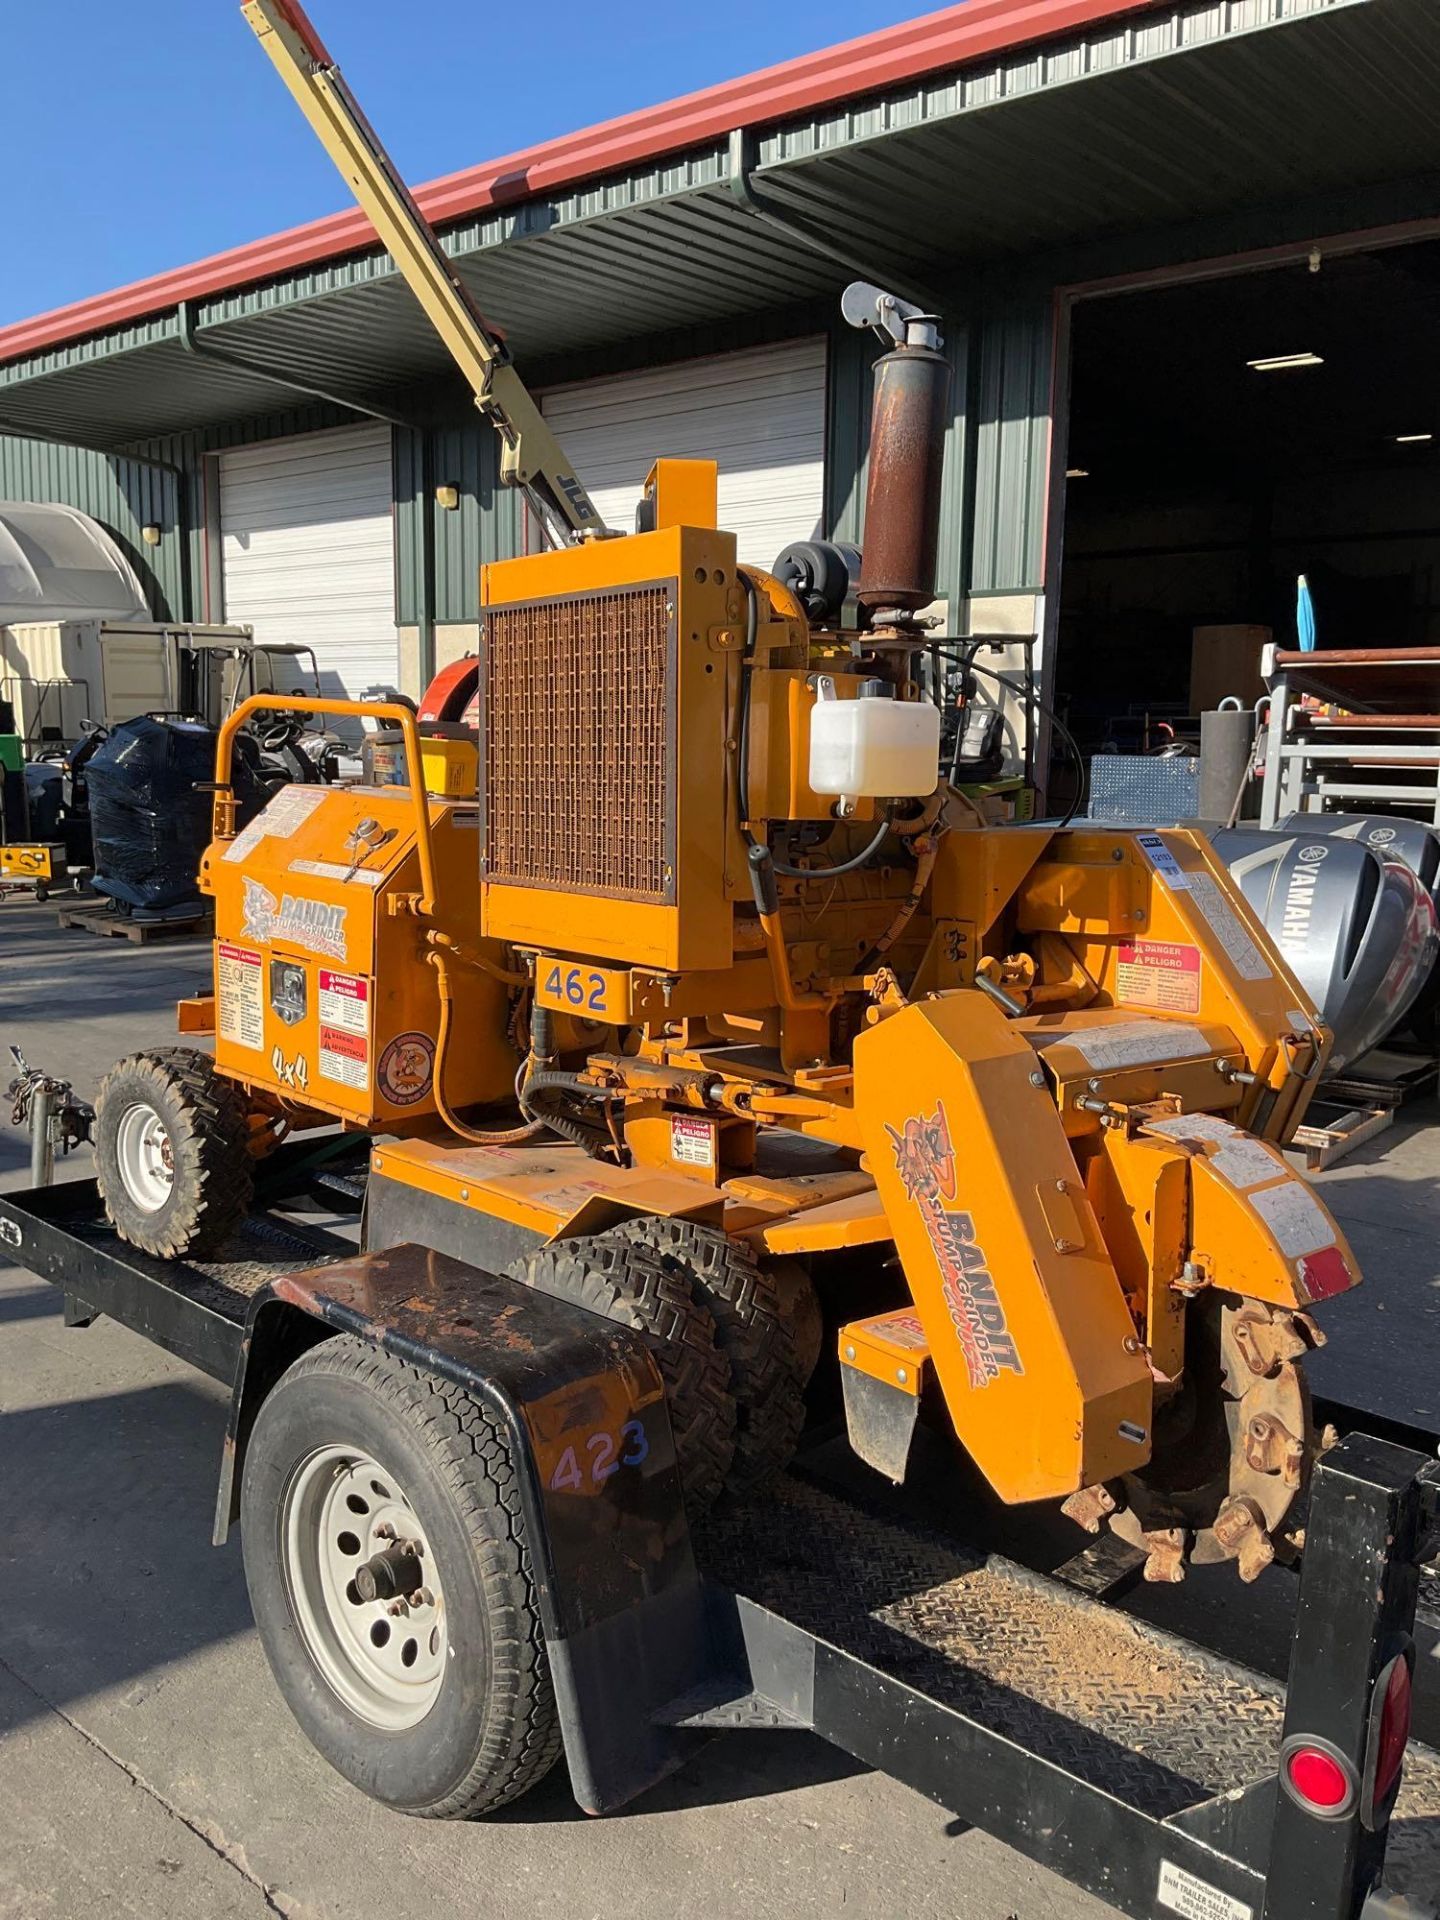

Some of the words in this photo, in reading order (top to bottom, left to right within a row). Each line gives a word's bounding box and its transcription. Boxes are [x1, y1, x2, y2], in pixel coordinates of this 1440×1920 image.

[556, 475, 595, 520] JLG
[281, 894, 347, 929] BANDIT
[1281, 862, 1321, 953] YAMAHA
[273, 916, 303, 931] STUMP
[304, 923, 344, 943] GRINDER
[1144, 944, 1181, 955] DANGER
[1144, 956, 1182, 967] PELIGRO
[335, 975, 357, 987] DANGER
[335, 985, 358, 997] PELIGRO
[545, 966, 607, 1011] 462
[682, 1127, 710, 1138] PELIGRO
[928, 1199, 962, 1271] STUMP
[956, 1278, 998, 1376] GRINDER
[945, 1212, 1023, 1373] BANDIT
[551, 1420, 649, 1490] 423
[1178, 1871, 1221, 1901] Manufactured
[1180, 1883, 1207, 1906] TRAILER
[1174, 1901, 1191, 1917] Made
